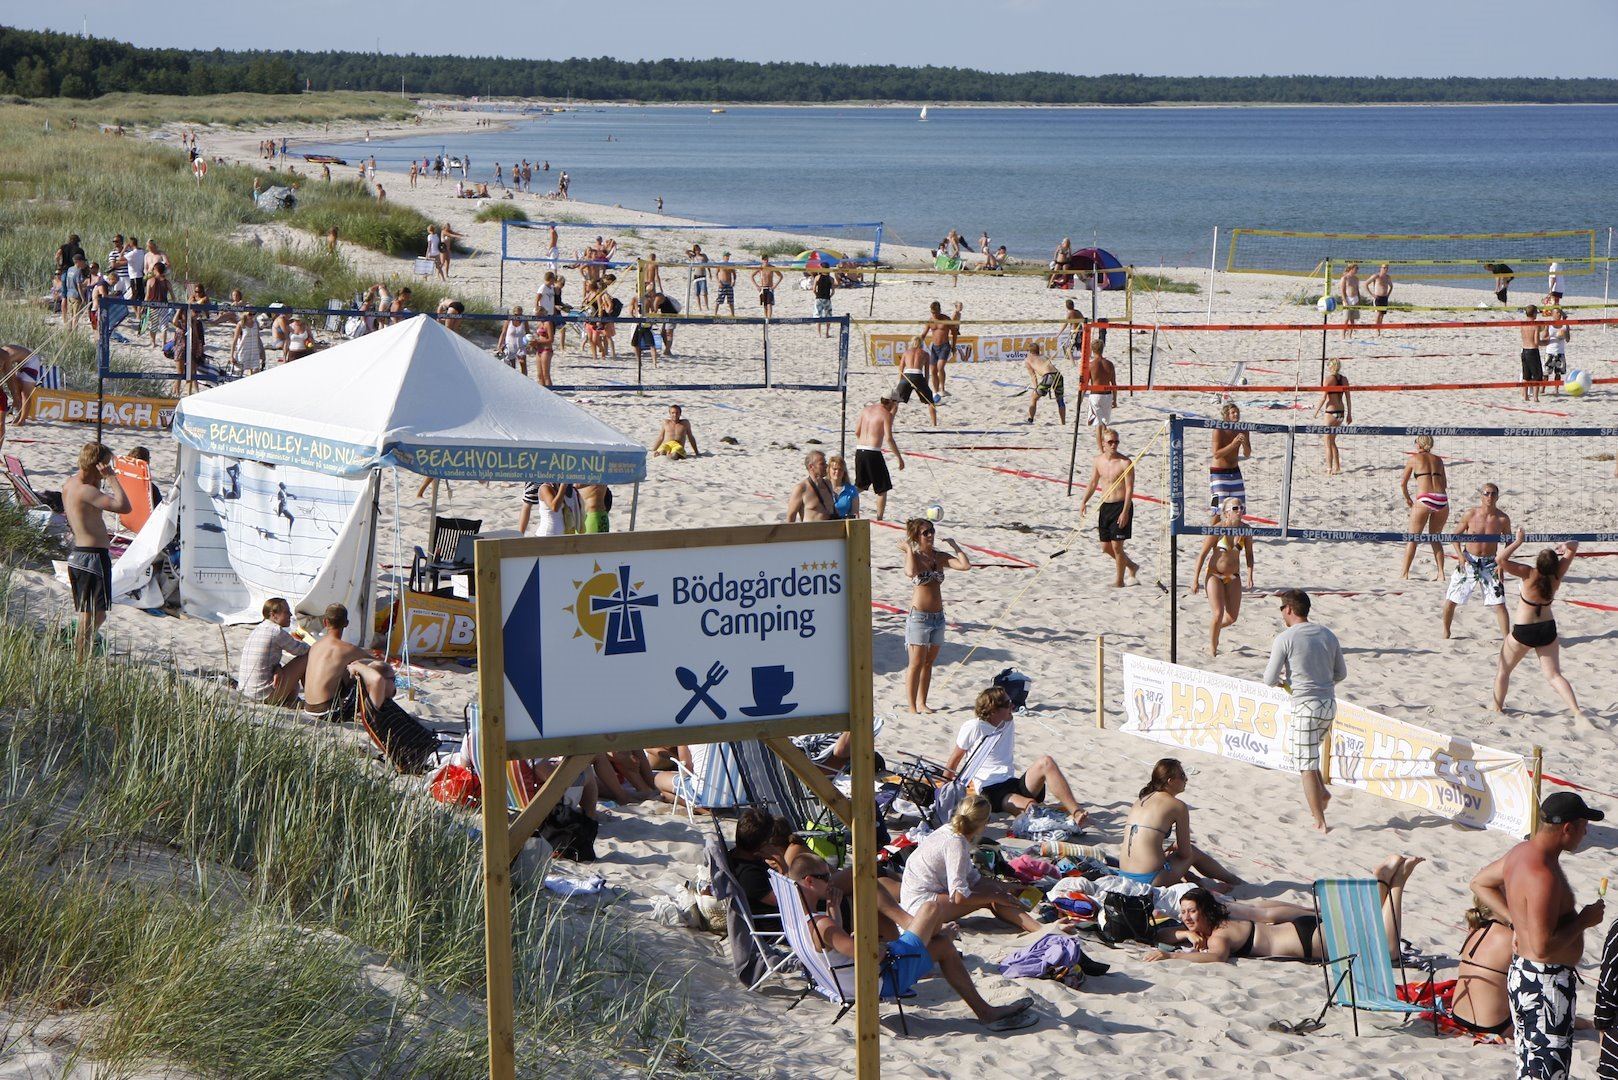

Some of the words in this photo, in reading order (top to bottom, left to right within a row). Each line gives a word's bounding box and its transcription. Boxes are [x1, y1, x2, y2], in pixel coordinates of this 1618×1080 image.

[68, 400, 153, 427] BEACH
[1204, 420, 1256, 432] SPECTRUM
[1306, 426, 1357, 434] SPECTRUM
[1406, 427, 1456, 435] SPECTRUM
[1504, 428, 1554, 436] SPECTRUM
[210, 424, 355, 464] BEACHVOLLEY-AID.NU
[416, 449, 606, 472] BEACHVOLLEY-AID.NU
[1201, 527, 1252, 536] SPECTRUM
[1302, 531, 1353, 539] SPECTRUM
[1402, 534, 1452, 542] SPECTRUM
[1500, 534, 1550, 542] SPETRUM
[673, 568, 841, 608] Bödagårdens
[701, 605, 816, 641] Camping
